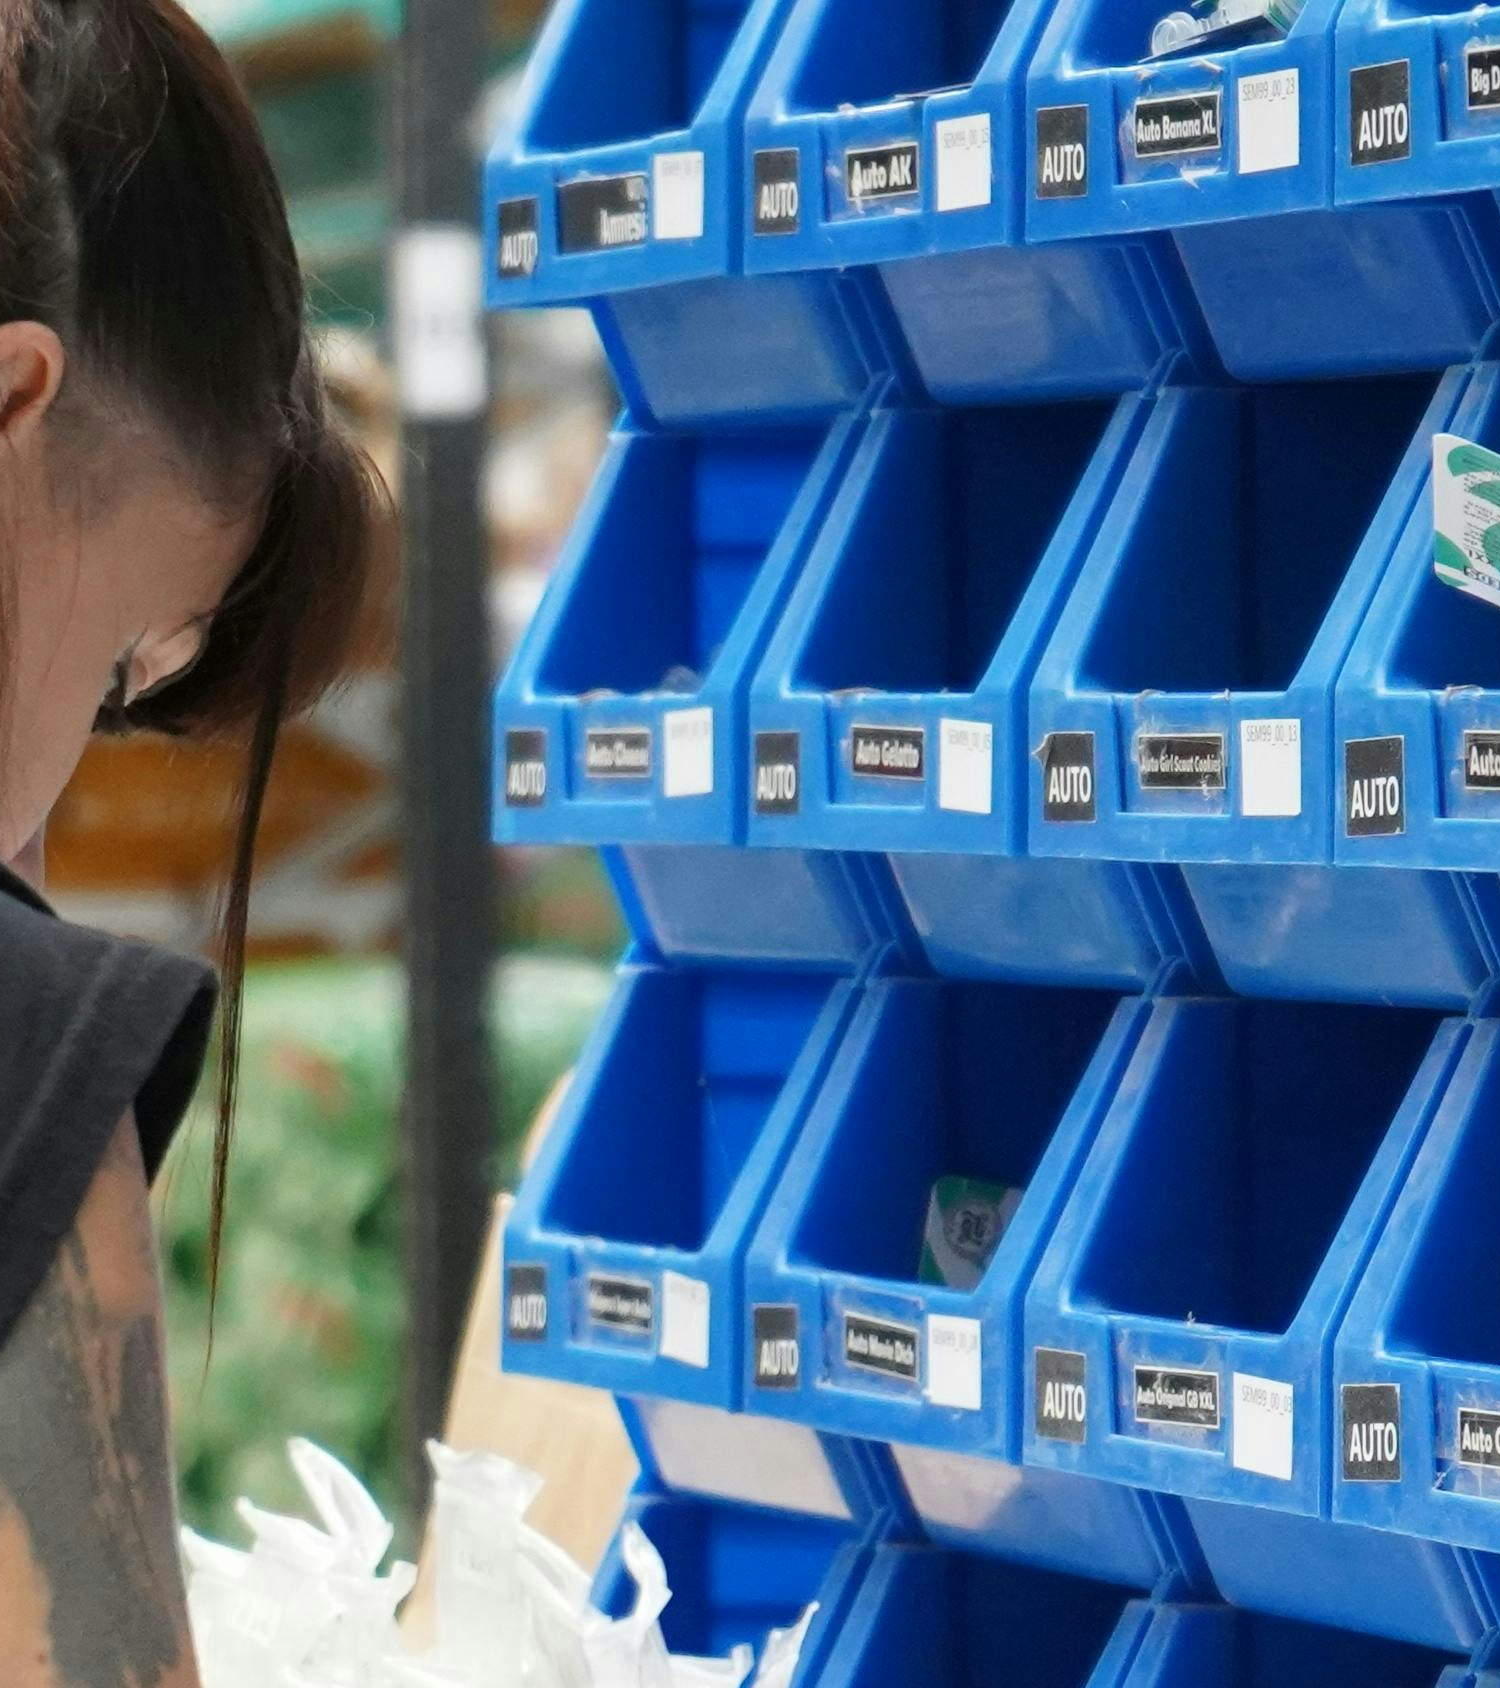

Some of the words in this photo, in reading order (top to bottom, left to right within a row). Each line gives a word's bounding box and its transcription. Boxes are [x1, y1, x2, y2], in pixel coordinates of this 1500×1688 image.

[1471, 68, 1490, 95] Big
[1136, 119, 1161, 144] Auto
[1162, 113, 1201, 141] Banana
[1201, 109, 1216, 135] XL
[1359, 102, 1408, 150] AUTO
[852, 158, 886, 192] Auto
[888, 152, 912, 186] AK
[1042, 145, 1084, 184] AUTO
[760, 181, 798, 220] AUTO
[501, 232, 538, 268] AUTO
[855, 738, 880, 767] Auto
[1141, 753, 1159, 773] Auto
[1159, 752, 1174, 774] Girl
[1174, 754, 1194, 773] Scout
[1194, 752, 1222, 773] Cookies
[508, 762, 546, 799] AUTO
[757, 763, 796, 802] AUTO
[1048, 765, 1091, 804] AUTO
[1351, 777, 1400, 818] AUTO
[510, 1293, 547, 1330] AUTO
[759, 1338, 798, 1376] AUTO
[1043, 1381, 1084, 1423] AUTO
[1137, 1388, 1155, 1405] Auto
[1155, 1388, 1185, 1410] Original
[1199, 1393, 1215, 1412] XXL
[1349, 1421, 1397, 1462] AUTO
[1462, 1422, 1493, 1453] Auto
